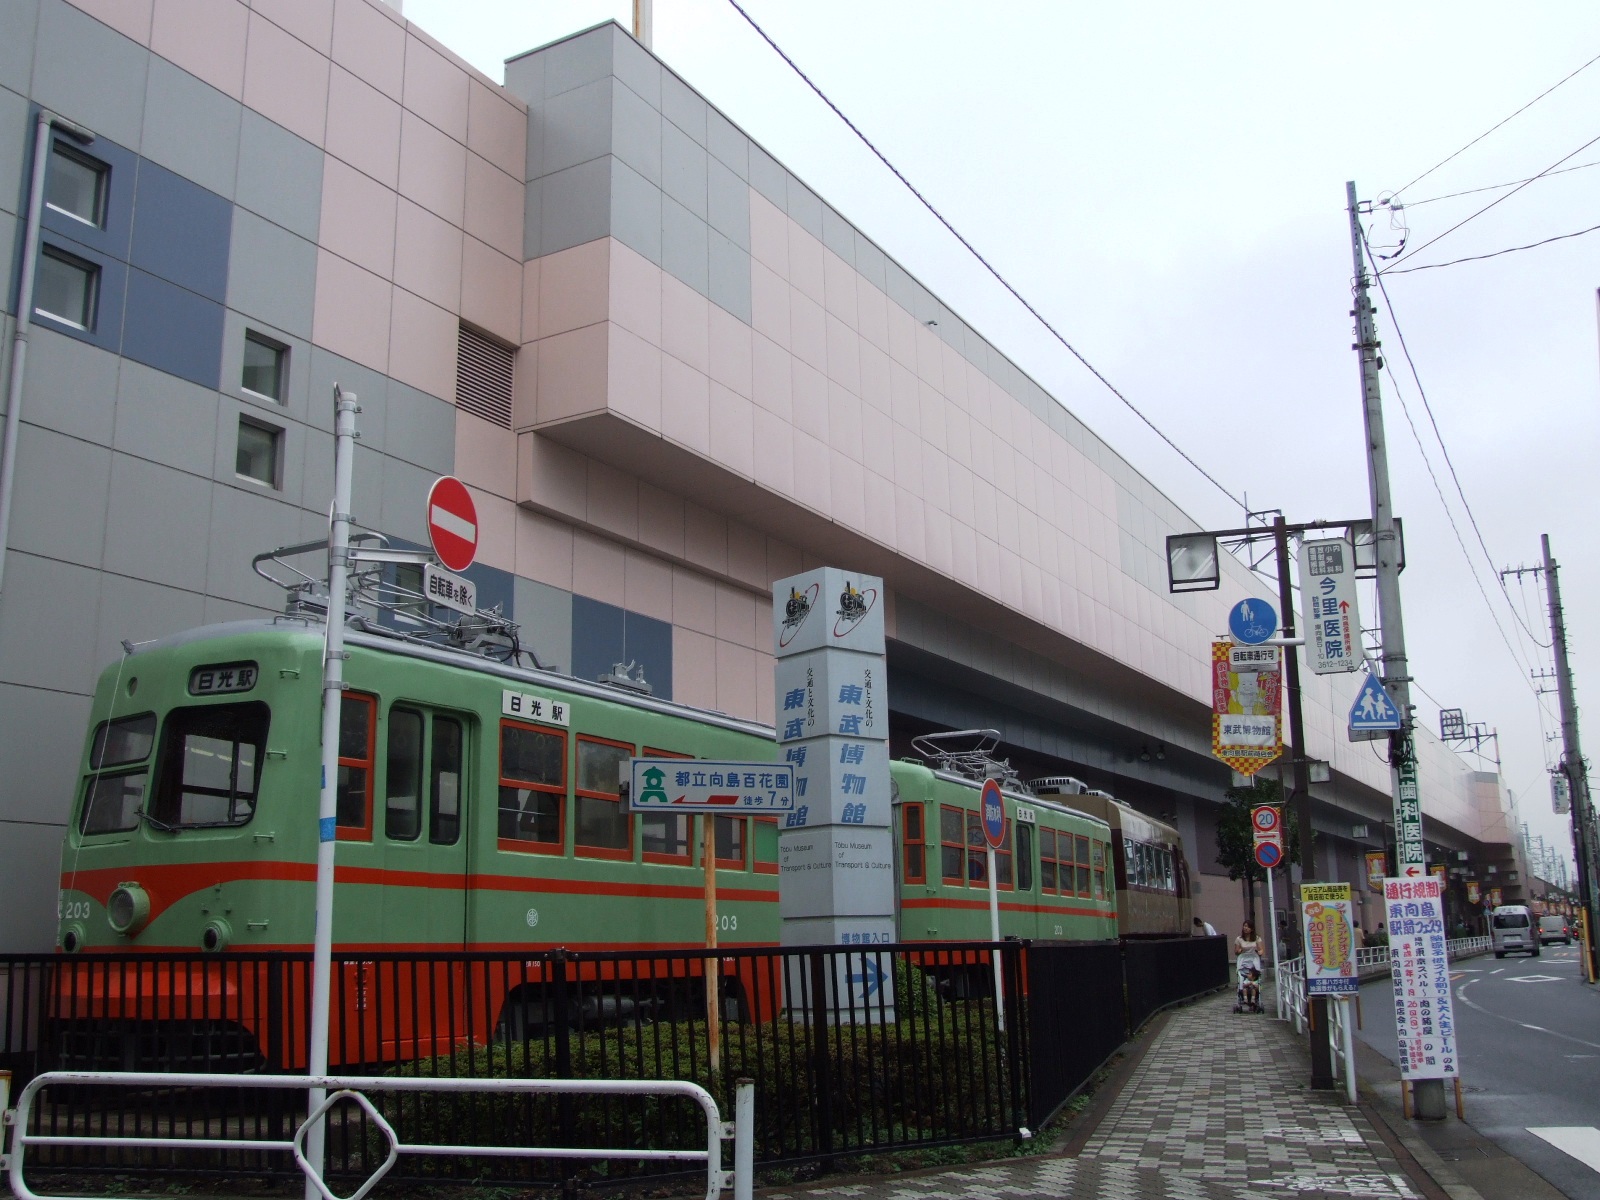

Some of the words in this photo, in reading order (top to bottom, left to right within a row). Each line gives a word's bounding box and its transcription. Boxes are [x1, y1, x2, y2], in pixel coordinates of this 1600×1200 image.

[430, 574, 473, 608] 自転車を除く
[1320, 577, 1343, 659] 今里医院
[1233, 650, 1275, 662] 自転車通行可
[198, 669, 253, 690] 日光駅
[806, 667, 815, 728] 交通と文化の
[864, 669, 873, 728] 交通と文化の
[511, 696, 563, 721] 日光駅
[1223, 724, 1272, 736] 東武博物館
[838, 684, 867, 824] 東武博物館
[675, 770, 789, 789] 都立向島百花園
[1258, 813, 1273, 825] 20
[794, 844, 814, 852] Museum
[781, 864, 805, 872] Transport
[835, 861, 863, 869] Transport
[1385, 881, 1440, 900] 通行規制
[65, 902, 90, 919] 203
[1389, 901, 1436, 918] 東向島
[1054, 925, 1063, 935] 203
[1389, 919, 1443, 936] 駅前フェスタ
[841, 932, 890, 944] 博物館入口
